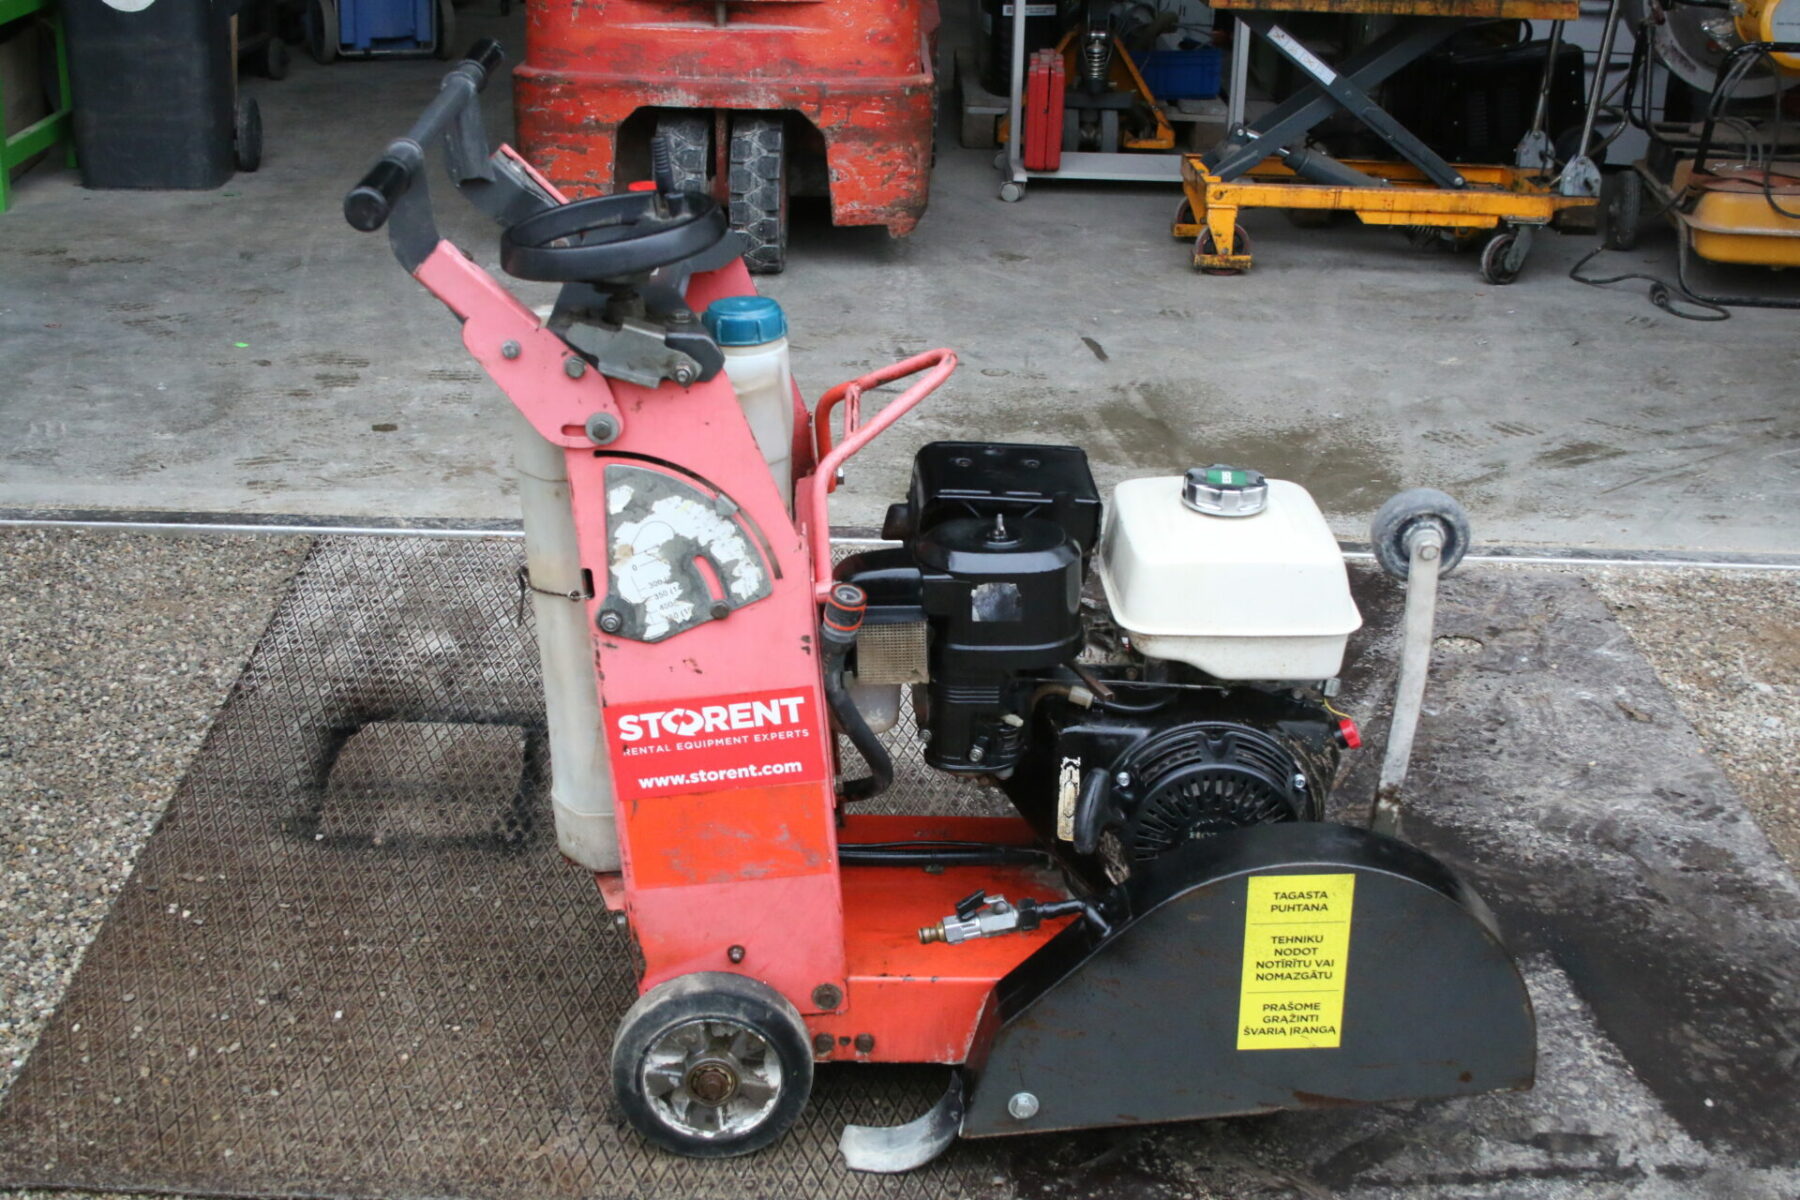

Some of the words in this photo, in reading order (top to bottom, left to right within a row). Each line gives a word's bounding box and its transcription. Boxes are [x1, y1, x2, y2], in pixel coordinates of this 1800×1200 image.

[618, 696, 805, 742] STORENT
[623, 744, 671, 756] RENTAL
[676, 735, 749, 751] EQUIPMENT
[754, 729, 810, 743] EXPERTS
[638, 761, 803, 789] www.storent.com
[1273, 890, 1328, 900] TAGASTA
[1270, 903, 1328, 913] PUHTANA
[1271, 935, 1324, 944] TEHNIKU
[1274, 947, 1318, 956] NODOT
[1256, 958, 1312, 969] NOTĪRĪTU
[1315, 959, 1334, 968] VAI
[1256, 970, 1333, 981] NOMAZGĀTU
[1262, 1001, 1321, 1012] PRAŠOME
[1262, 1013, 1319, 1025] GRĄŽINTI
[1243, 1024, 1286, 1036] ŠVARIĄ
